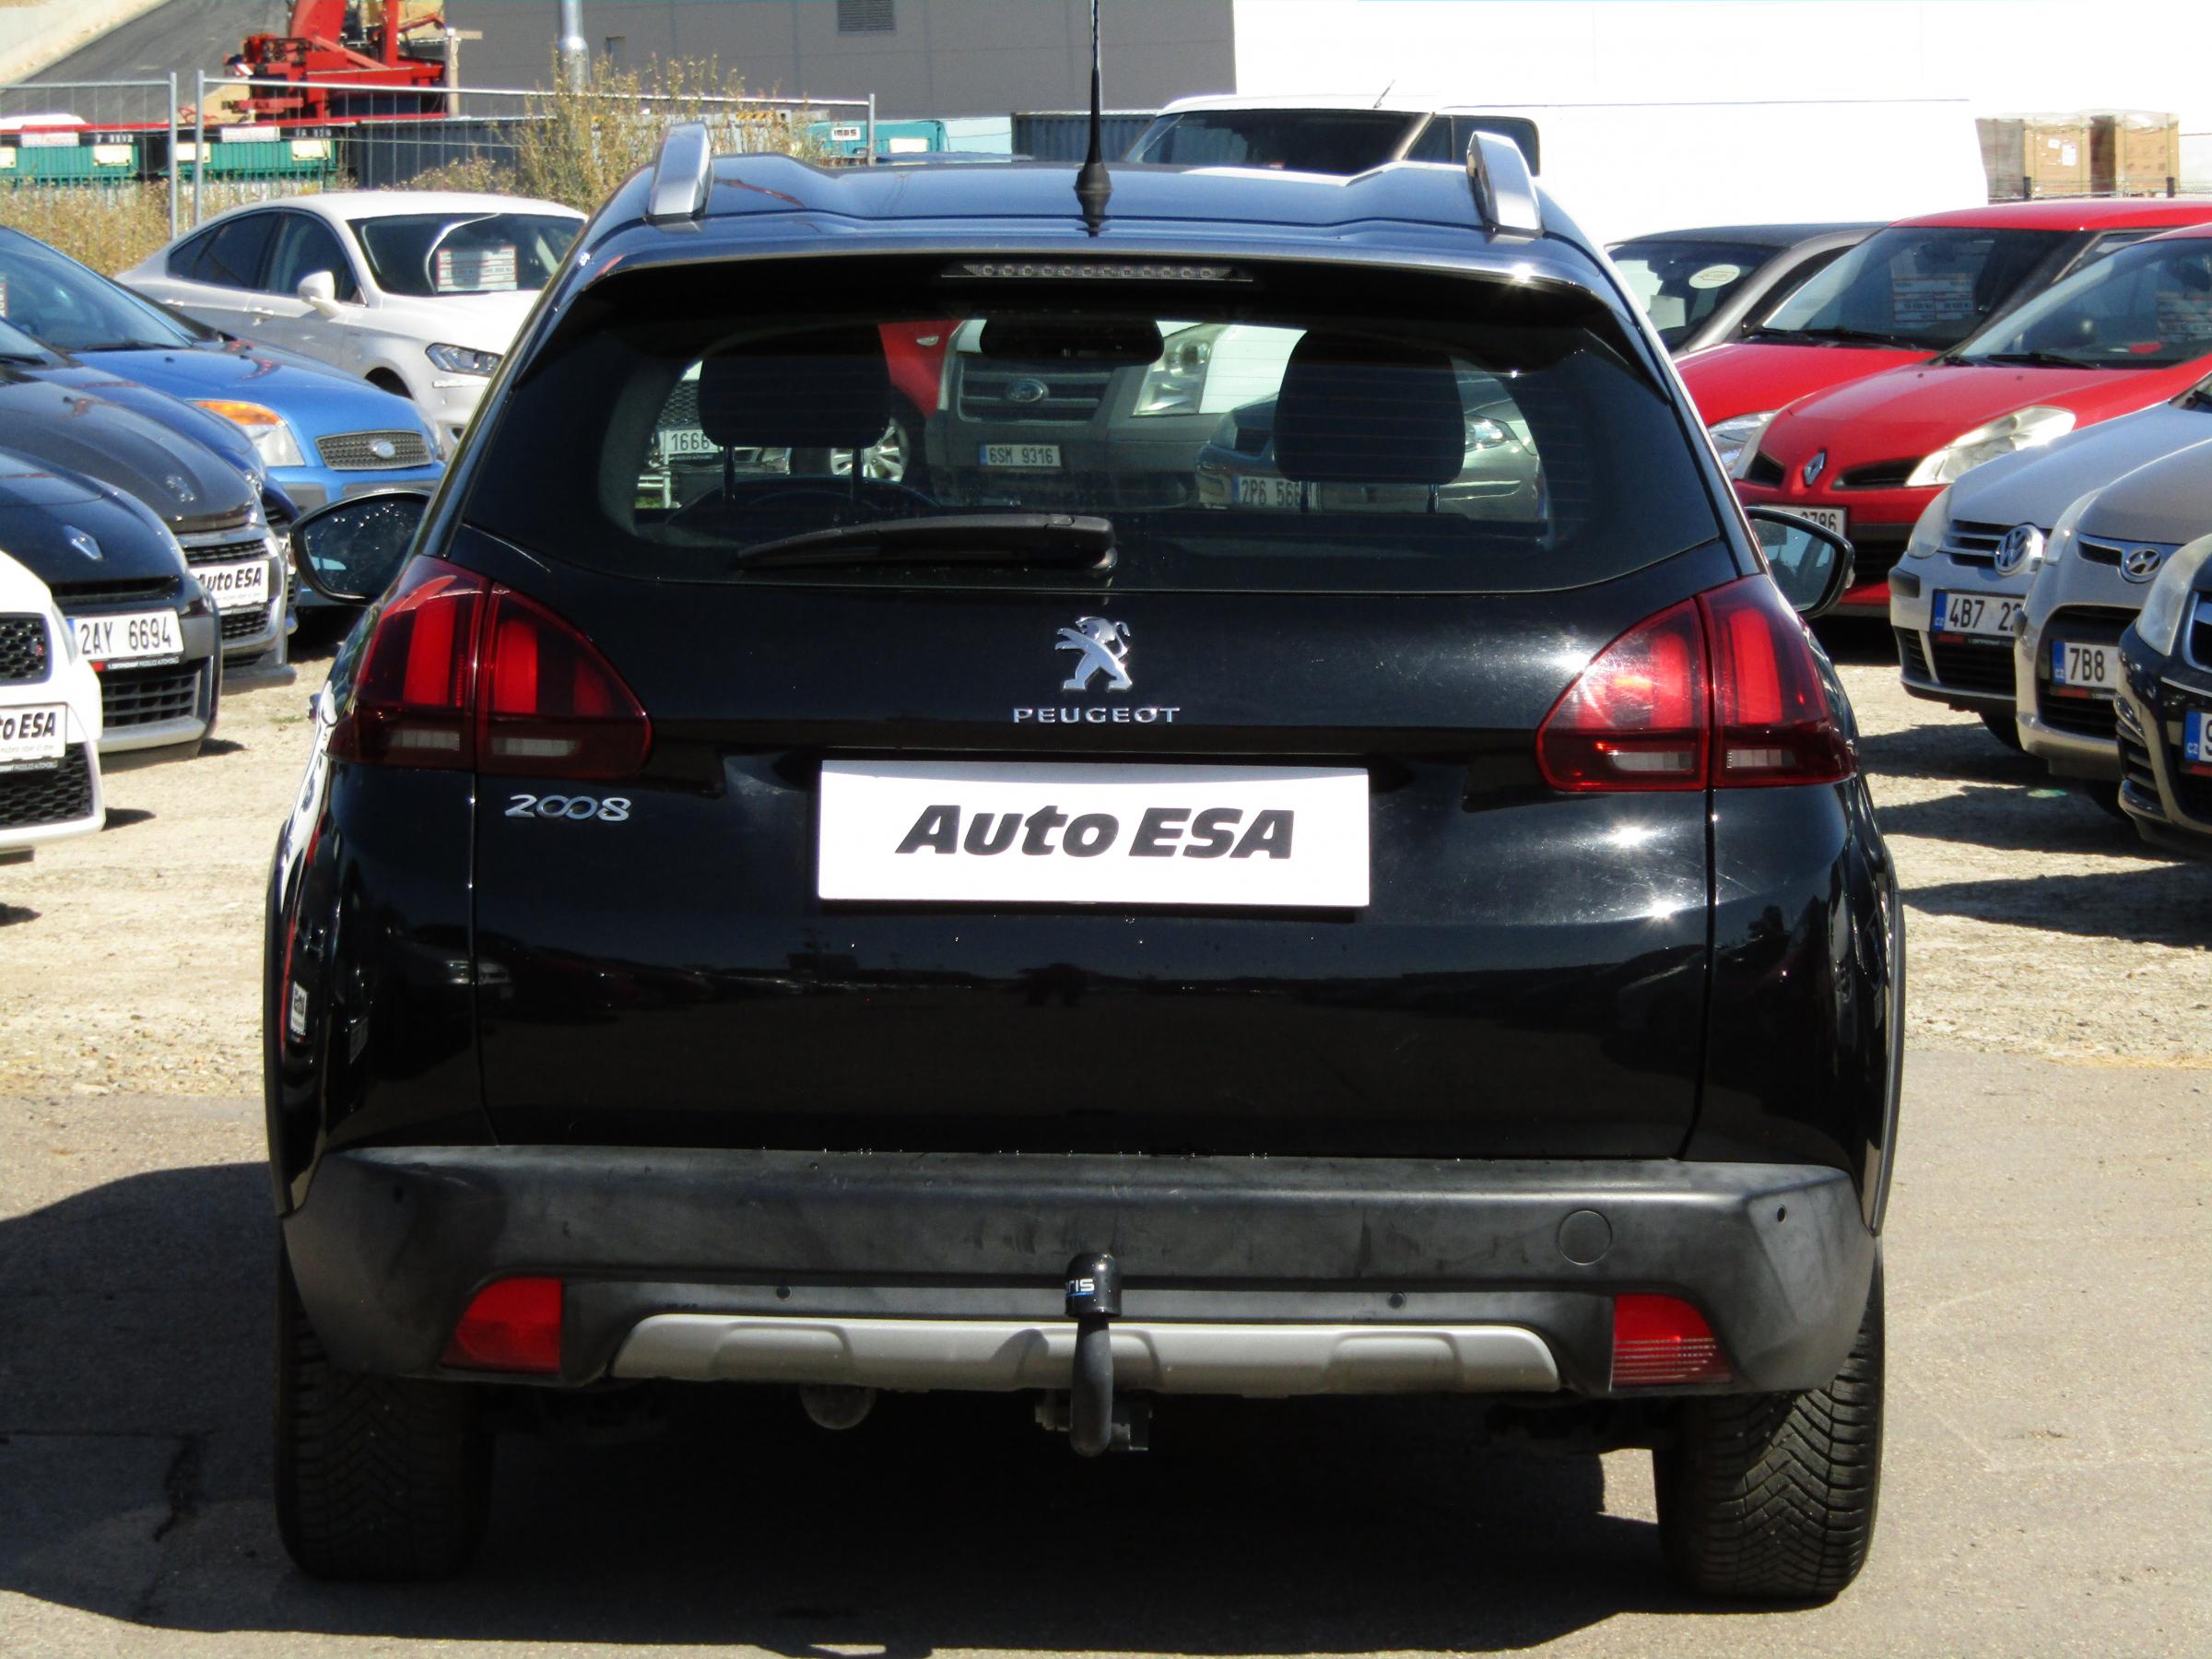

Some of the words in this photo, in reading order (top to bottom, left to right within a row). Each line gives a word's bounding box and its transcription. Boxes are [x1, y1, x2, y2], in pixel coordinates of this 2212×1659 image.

[988, 447, 1013, 464] 6SM
[1021, 447, 1053, 465] 9316
[1241, 479, 1267, 507] 2P6
[234, 567, 263, 590] ESA
[1948, 598, 1985, 629] 4B7
[80, 621, 113, 655] 2AY
[128, 616, 172, 651] 6694
[2069, 647, 2105, 682] 7B8
[18, 712, 57, 739] ESA
[1014, 707, 1180, 724] PEUGEOT
[504, 794, 632, 822] 2008
[894, 804, 1120, 858] Auto
[1128, 806, 1295, 860] ESA
